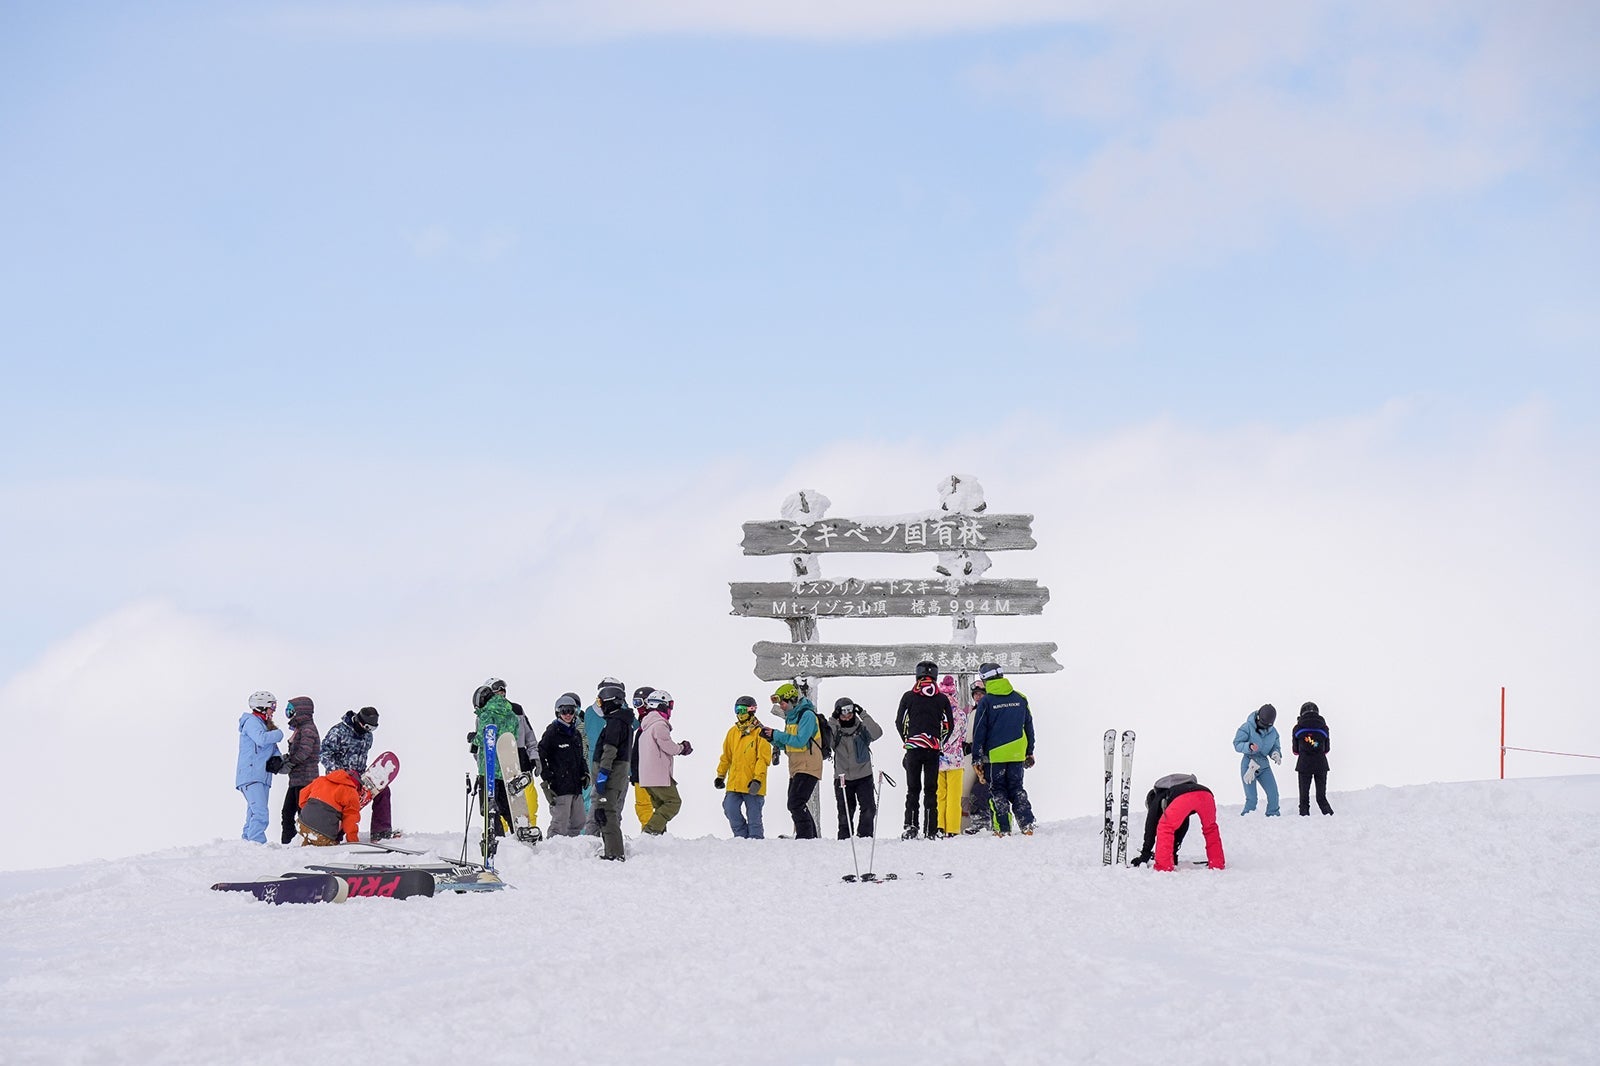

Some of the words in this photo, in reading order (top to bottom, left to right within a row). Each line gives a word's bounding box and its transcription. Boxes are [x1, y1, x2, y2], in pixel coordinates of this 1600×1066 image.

[787, 519, 986, 548] ヌキベツ国有林
[780, 652, 897, 668] 北海道森林管理局
